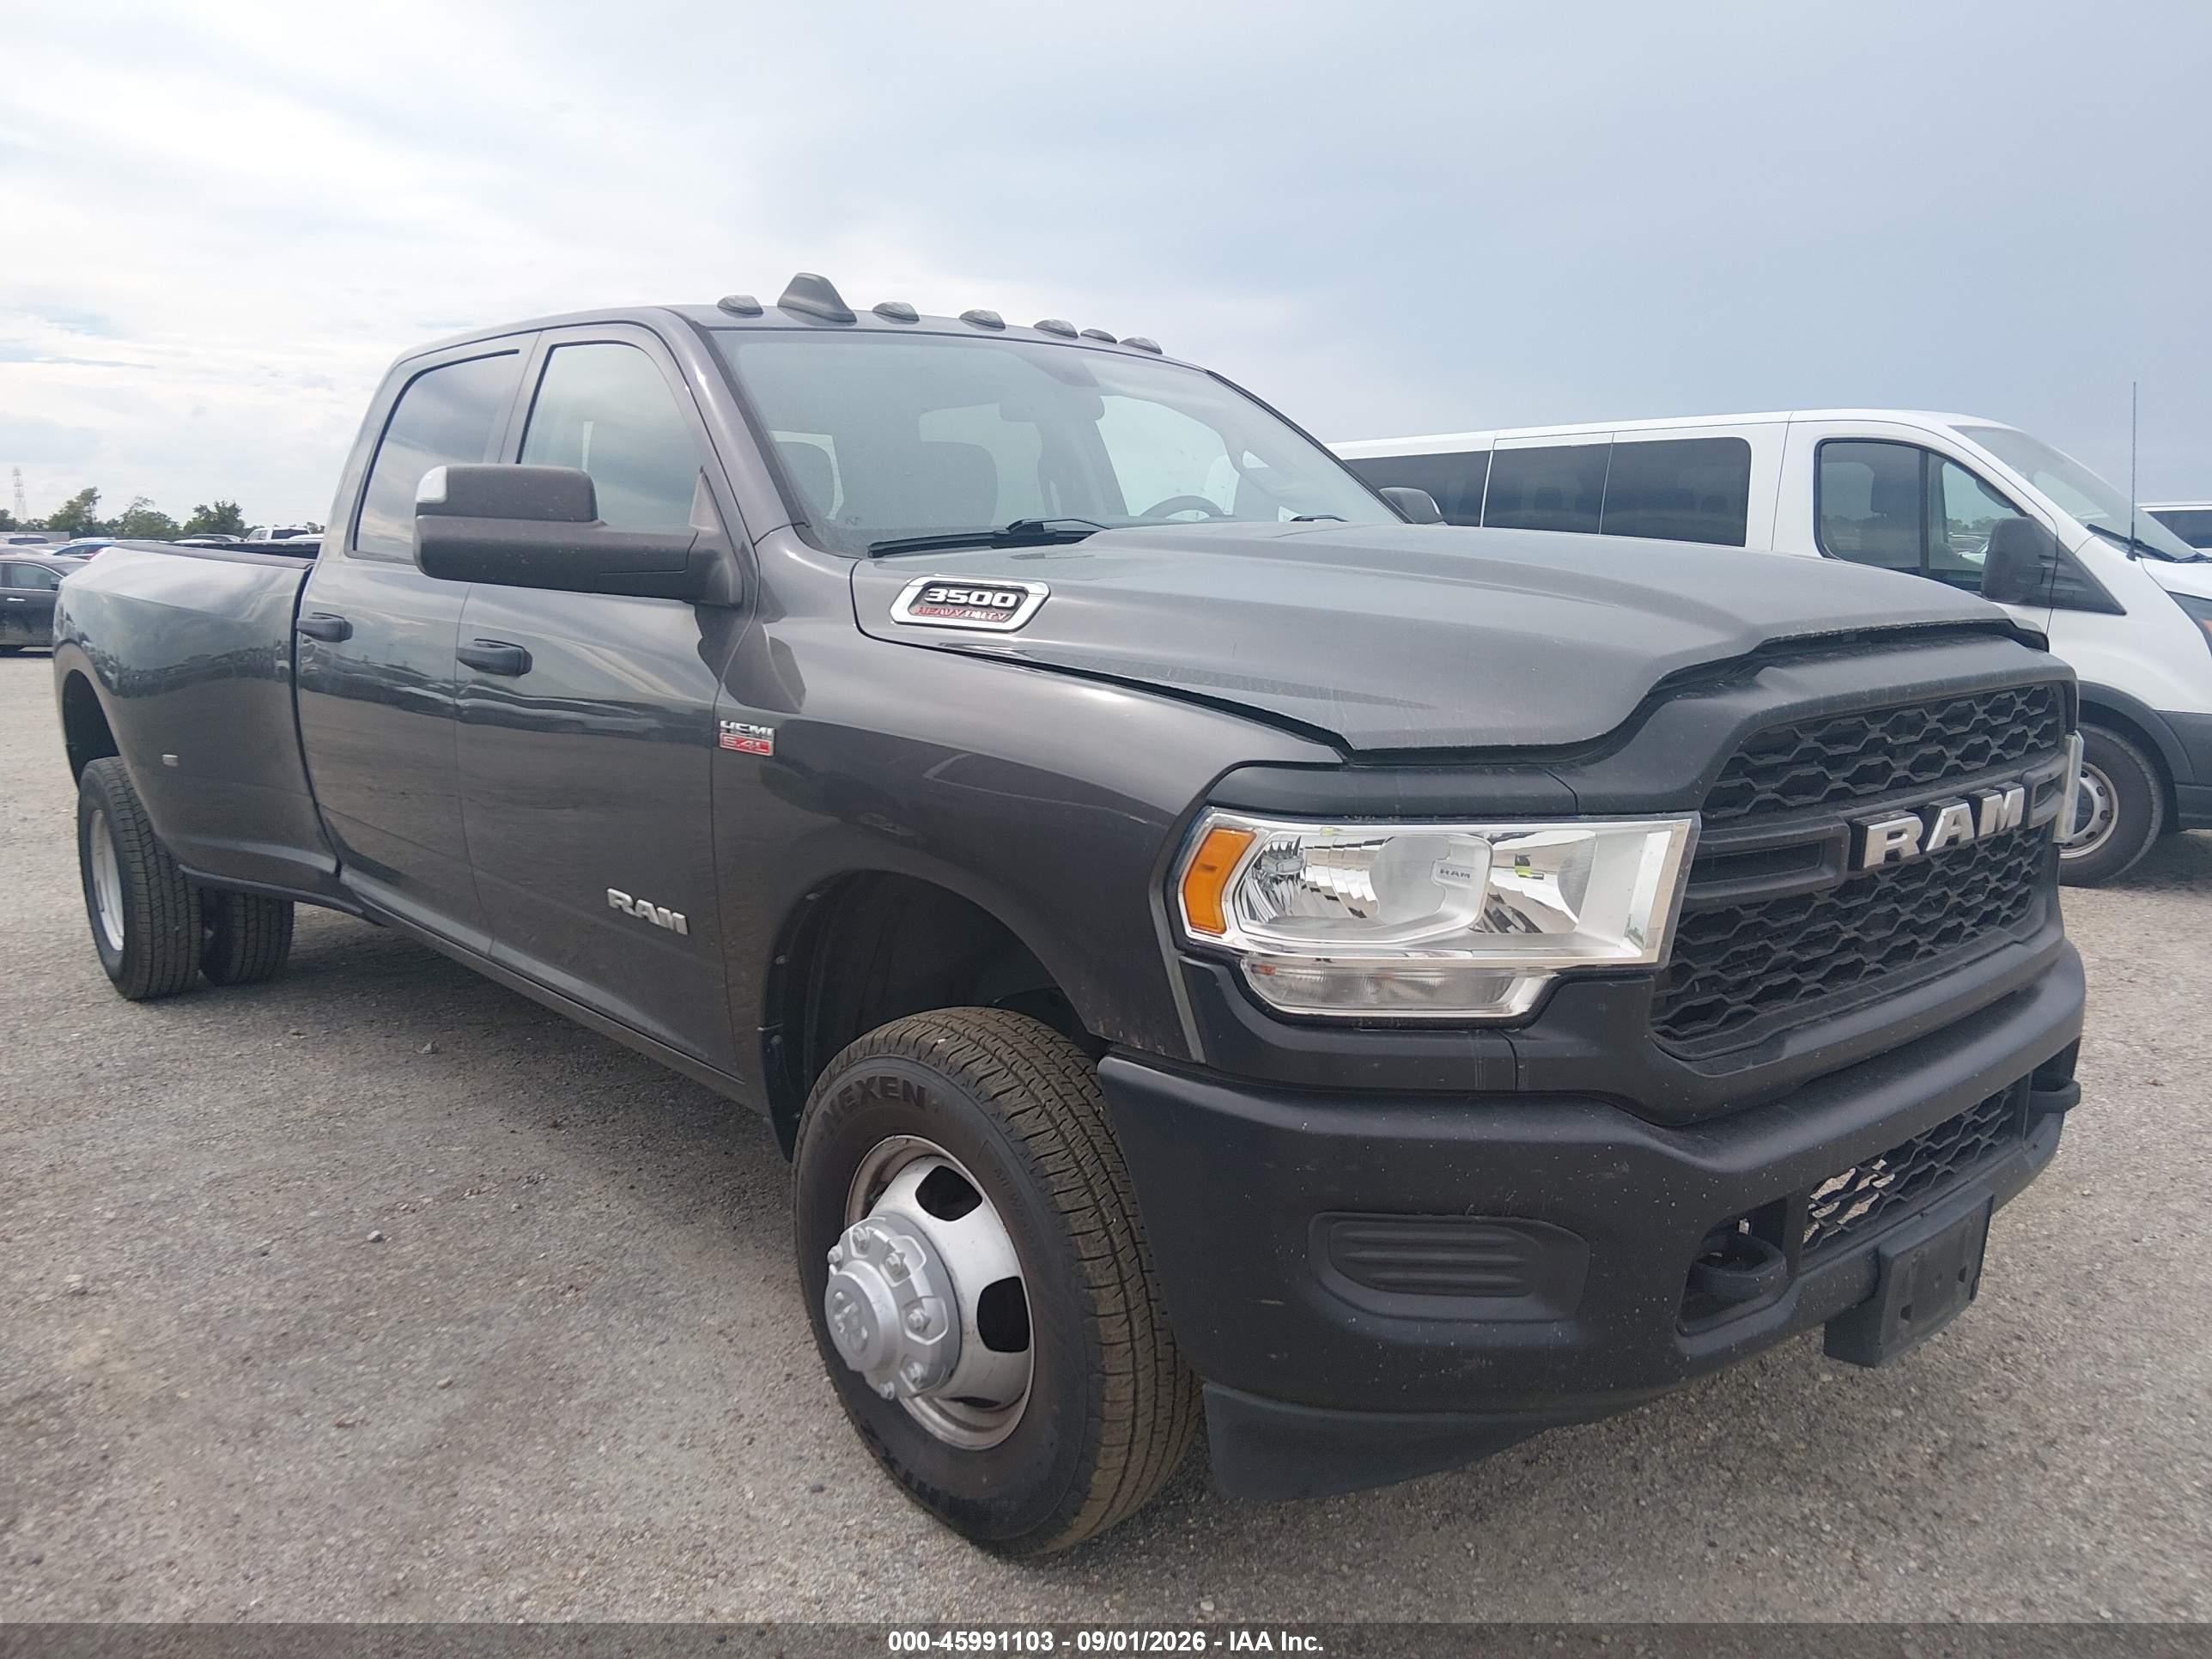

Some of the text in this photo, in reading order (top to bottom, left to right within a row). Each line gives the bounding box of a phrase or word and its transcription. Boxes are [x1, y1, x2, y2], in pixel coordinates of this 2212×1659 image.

[916, 606, 963, 617] HEAVY
[924, 588, 1018, 608] 3500
[1860, 784, 2026, 869] RAM
[1439, 868, 1471, 878] RAM
[606, 888, 689, 935] RAM
[822, 1075, 927, 1128] NEXEN
